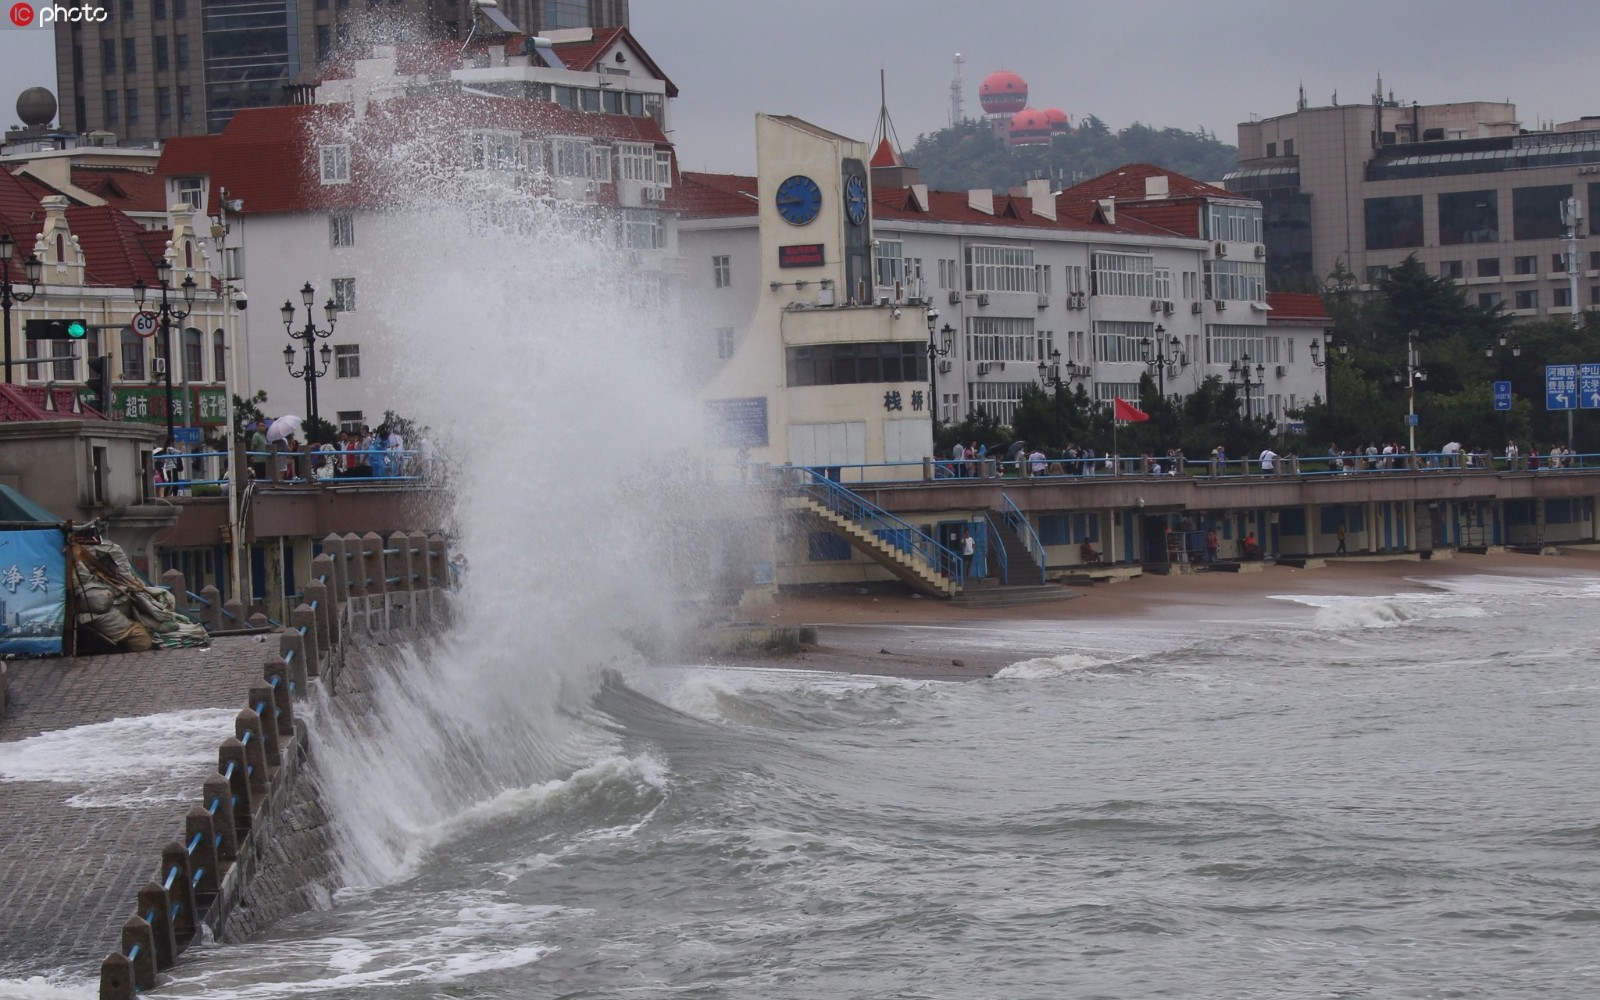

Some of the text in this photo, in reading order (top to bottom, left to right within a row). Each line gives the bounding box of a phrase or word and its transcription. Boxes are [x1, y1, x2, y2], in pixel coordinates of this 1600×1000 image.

[137, 318, 152, 329] 60
[1548, 367, 1575, 376] 河南路
[126, 395, 147, 418] 超市
[884, 390, 924, 412] 栈桥
[1, 564, 49, 594] 净美
